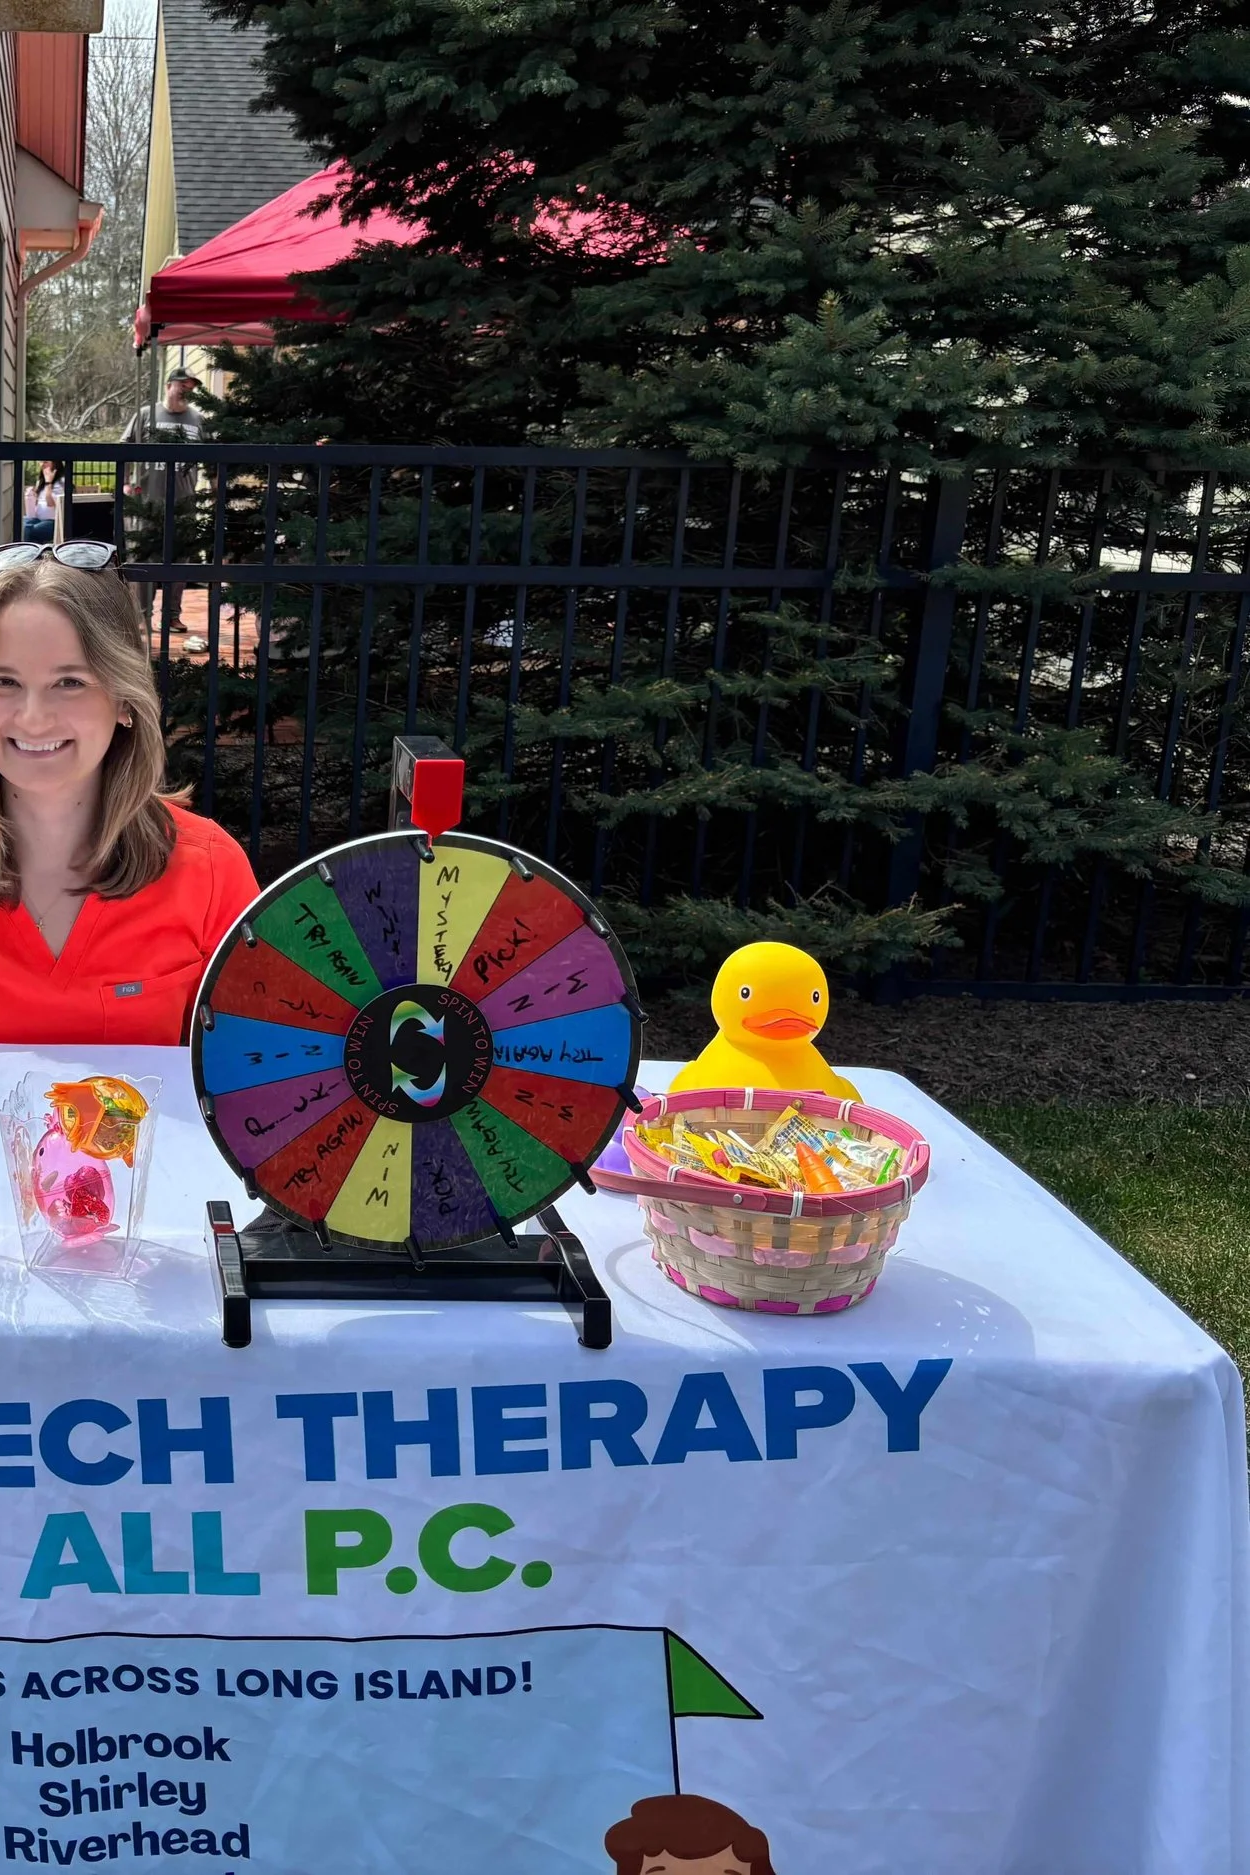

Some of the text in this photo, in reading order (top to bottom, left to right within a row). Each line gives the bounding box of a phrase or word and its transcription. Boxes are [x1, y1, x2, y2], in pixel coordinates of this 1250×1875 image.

[294, 903, 331, 950] TRY
[434, 865, 459, 981] MYSTERY
[472, 917, 539, 985] PICK!
[507, 967, 589, 1013] WIN
[348, 1015, 399, 1114] SPIN TO WIN
[437, 993, 489, 1094] SPIN TO WIN
[559, 1040, 603, 1064] TRY
[514, 1088, 574, 1123] WIN
[283, 1162, 322, 1190] TRY
[365, 1142, 399, 1207] WIN
[498, 1157, 526, 1193] TRY
[276, 1358, 954, 1482] THERAPY
[19, 1511, 262, 1600] ALL
[305, 1502, 553, 1596] P.C.
[20, 1664, 200, 1701] ACROSS
[216, 1668, 339, 1700] LONG
[355, 1661, 533, 1701] ISLAND!
[11, 1726, 232, 1768] Holbrook
[39, 1771, 207, 1818] Shirley
[3, 1821, 250, 1865] Riverhead
